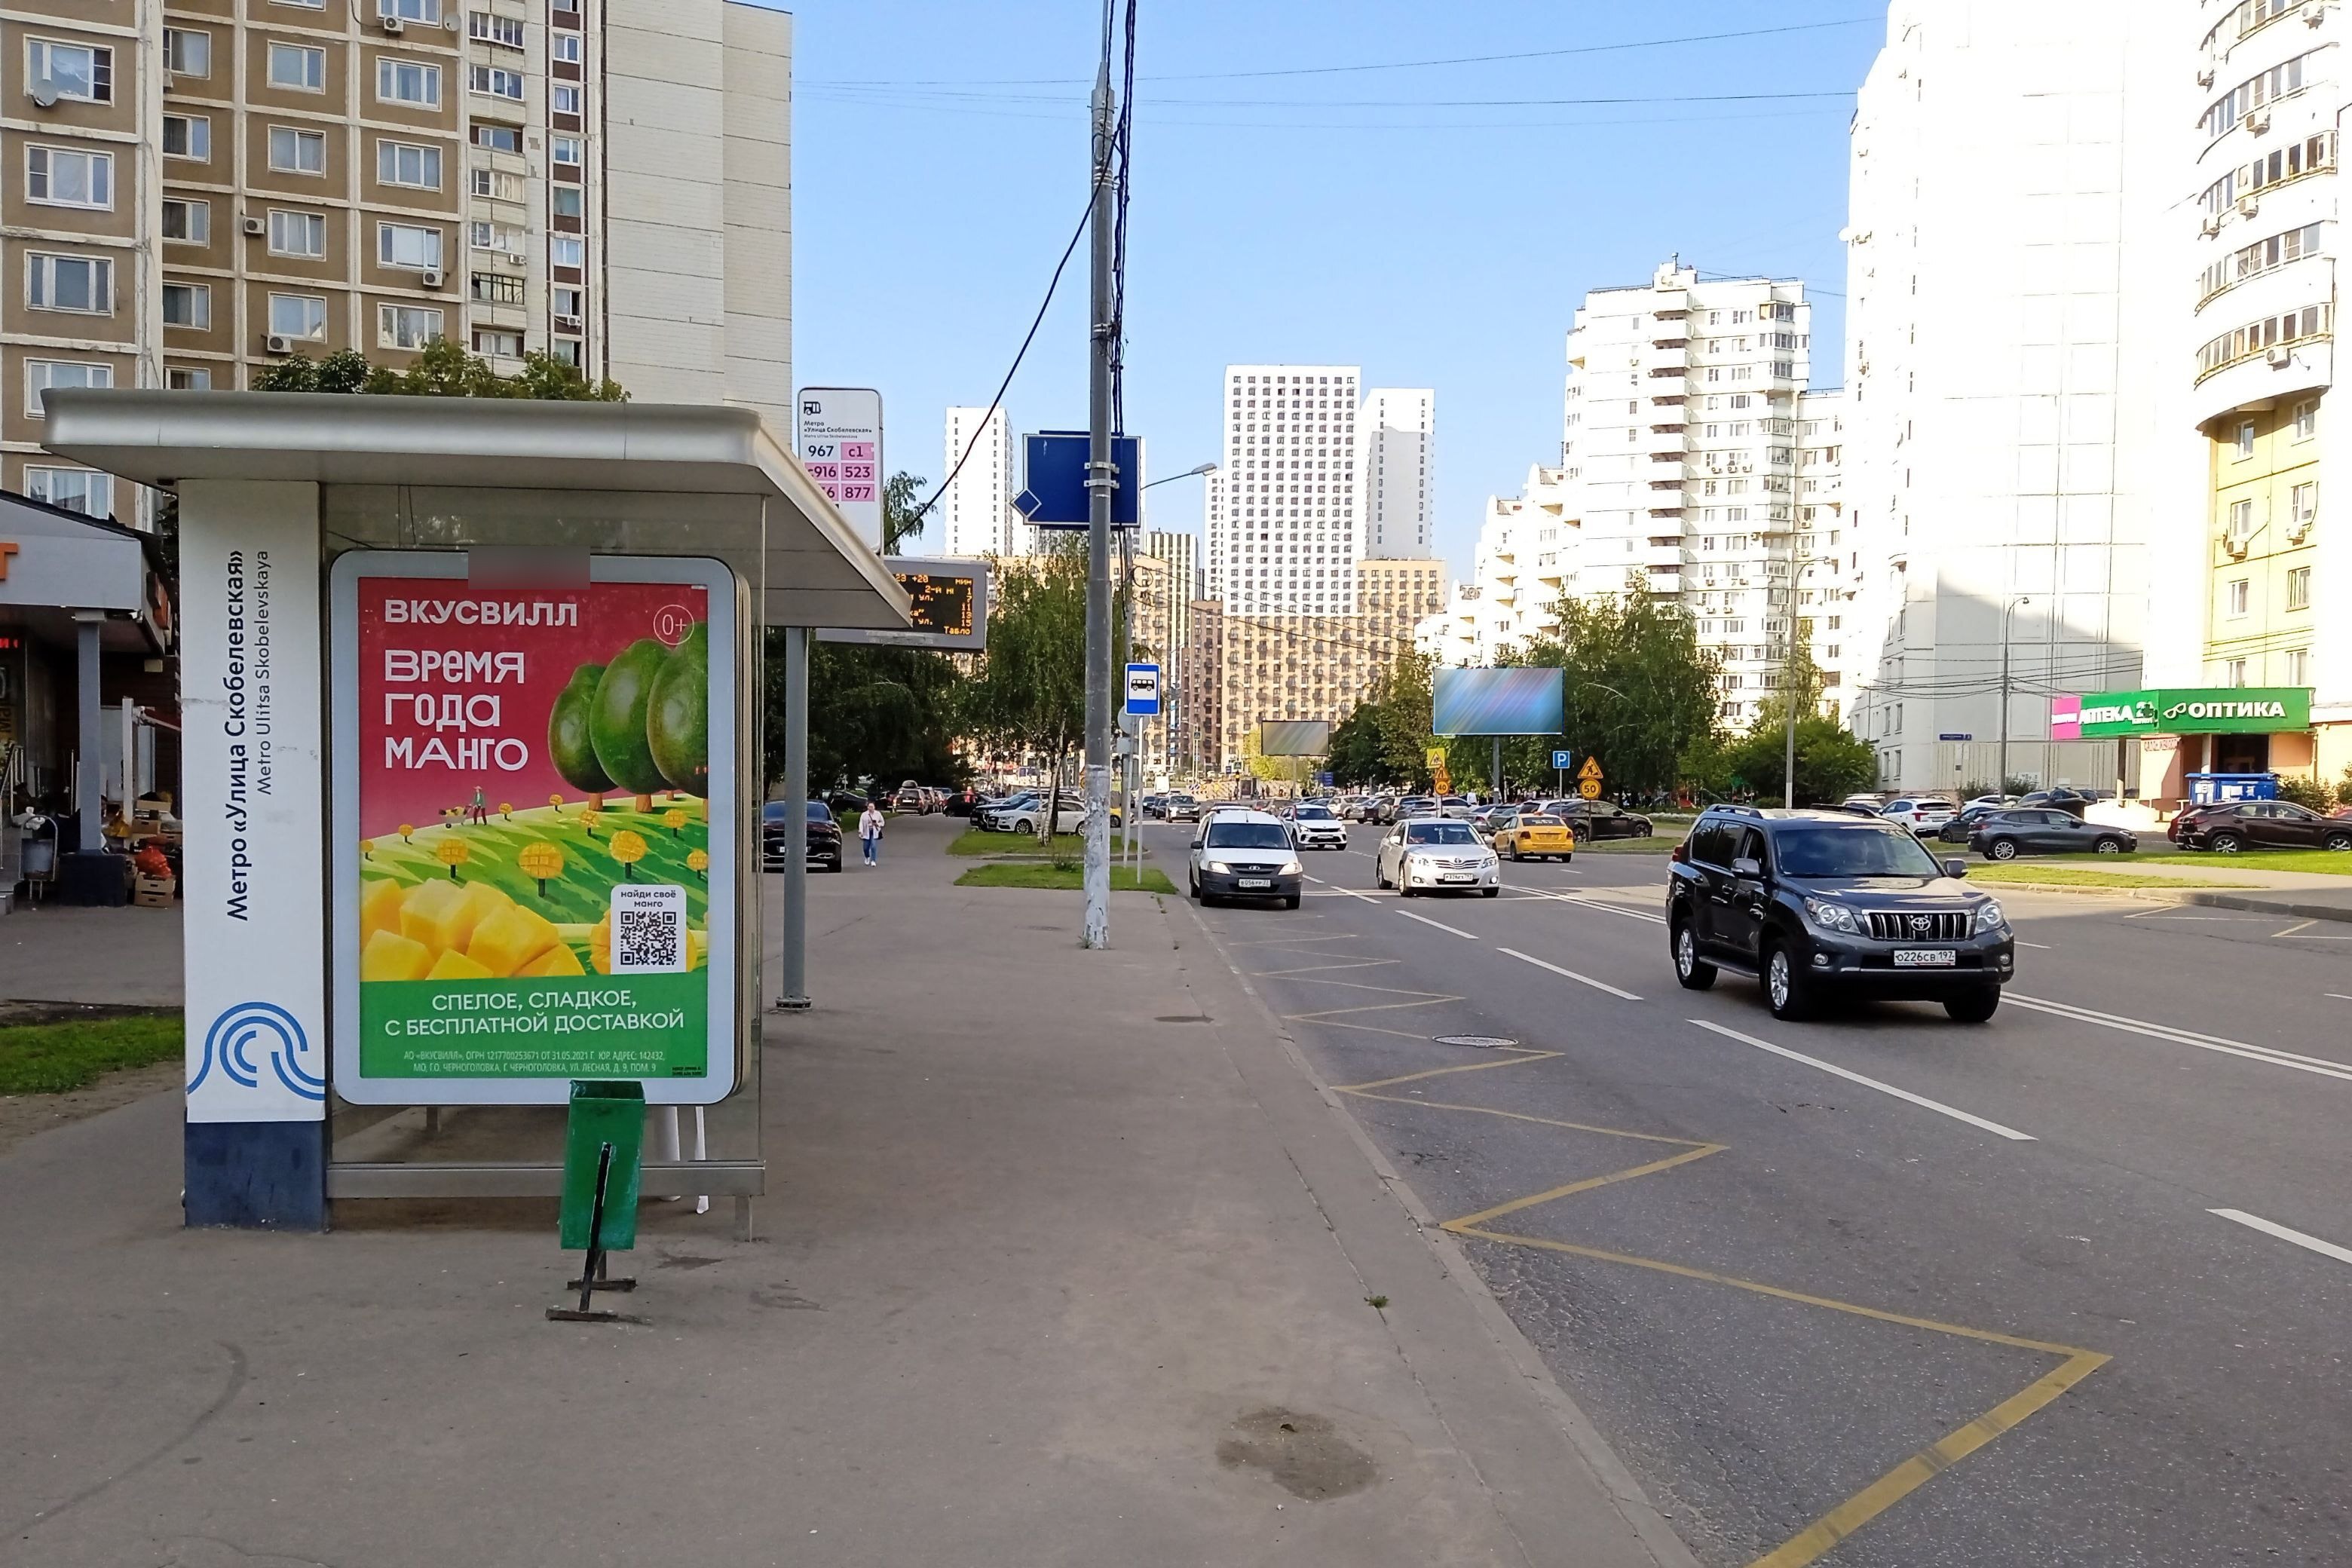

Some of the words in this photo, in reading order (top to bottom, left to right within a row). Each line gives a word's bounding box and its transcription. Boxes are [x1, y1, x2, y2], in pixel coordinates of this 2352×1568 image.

[808, 445, 835, 457] 967
[844, 466, 871, 478] 523
[844, 487, 871, 499] 877
[253, 550, 272, 679] Skobelevskaya
[385, 599, 578, 626] ВКУСВИЛЛ
[661, 614, 688, 635] 0+
[943, 626, 971, 635] Табло
[222, 550, 247, 737] Скобелевская»
[256, 684, 271, 735] Ulitsa
[2078, 706, 2133, 725] АПТЕКА
[2188, 701, 2286, 718] ОПТИКА
[385, 737, 528, 771] МАНГО
[256, 740, 272, 795] Metro
[225, 744, 250, 832] «Улица
[1584, 785, 1596, 793] 50
[227, 838, 253, 921] Метро
[620, 890, 651, 899] найди
[1938, 951, 1952, 959] 197
[432, 993, 523, 1012] СПЕЛОЕ,
[528, 990, 637, 1011] СЛАДКОЕ,
[384, 1020, 400, 1036] С
[407, 1012, 548, 1036] БЕСПЛАТНОЙ
[554, 1008, 684, 1034] ДОСТАВКОЙ
[466, 1050, 485, 1061] ОГРН
[541, 1050, 550, 1060] ОТ
[552, 1050, 588, 1061] 31.05.2021
[651, 1062, 657, 1072] 9
